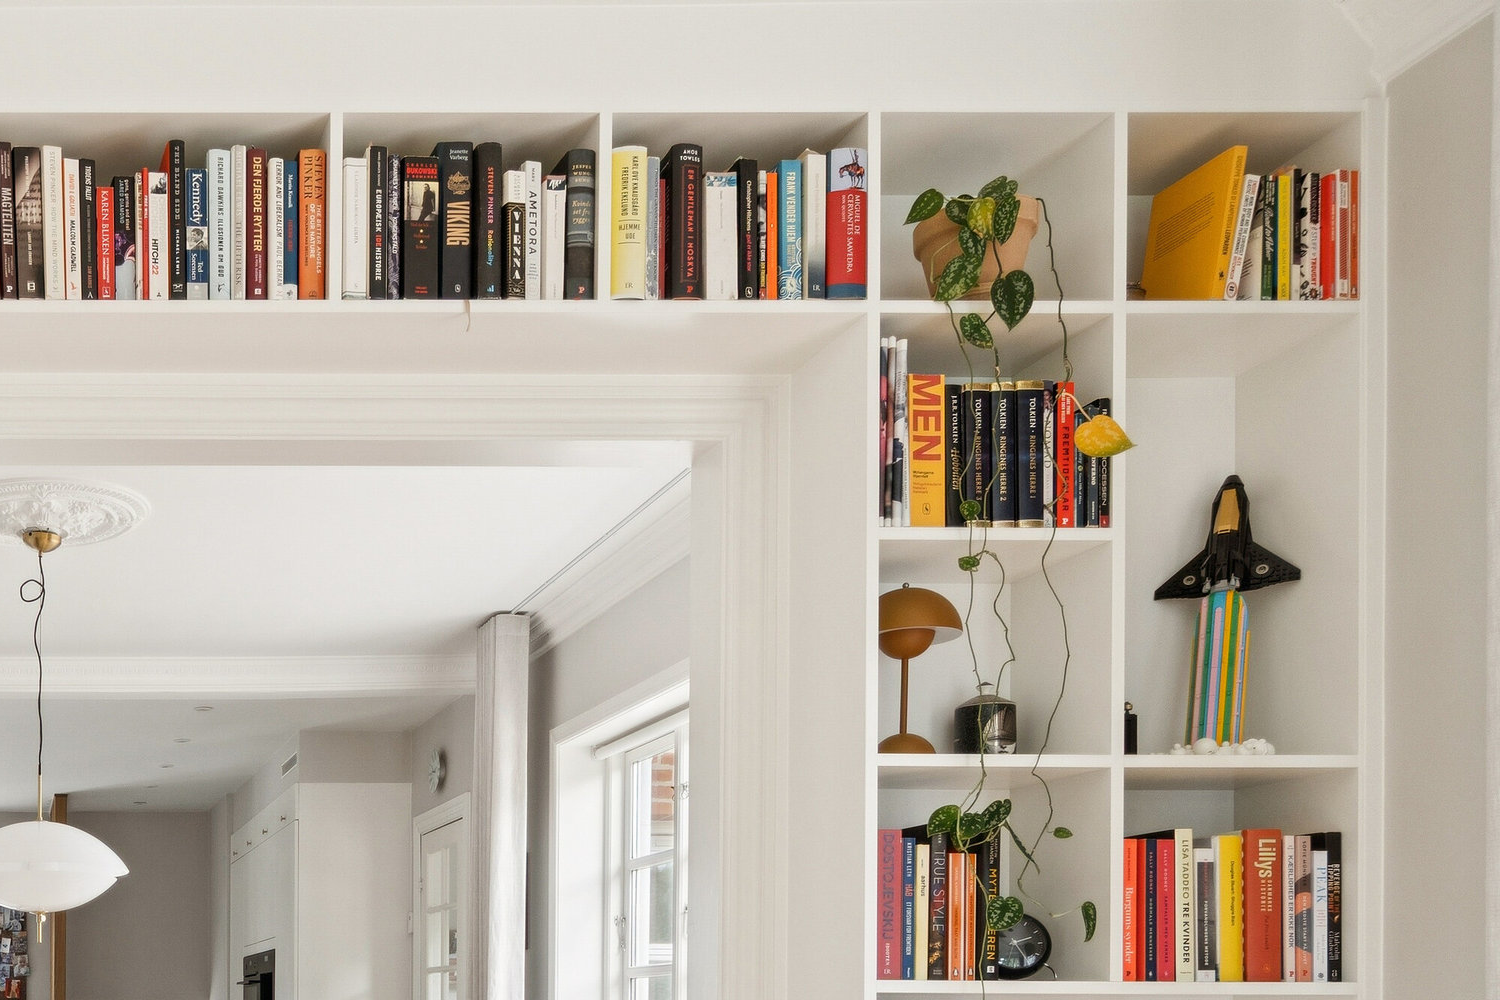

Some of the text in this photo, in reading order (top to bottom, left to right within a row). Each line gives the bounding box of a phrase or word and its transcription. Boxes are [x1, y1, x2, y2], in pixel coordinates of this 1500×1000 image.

[253, 157, 262, 176] DEN
[304, 156, 313, 199] PINKER
[314, 155, 322, 200] STEVEN
[621, 167, 629, 191] FREDRIK
[687, 169, 694, 179] EN
[190, 173, 202, 224] Kennedy
[253, 179, 262, 213] FJERDE
[631, 182, 639, 216] KNAUSGÅRD
[786, 172, 796, 242] FRANK VENDER HJEM
[1, 187, 13, 245] MAGTELITEN
[253, 215, 262, 252] RYTTER
[446, 201, 470, 246] VIKING
[529, 190, 537, 255] AMETORA
[854, 225, 860, 235] DE
[218, 254, 224, 263] OM
[486, 229, 494, 266] Rationality
[152, 264, 158, 275] 22
[912, 374, 941, 461] MEN
[1254, 839, 1276, 878] Lillys
[905, 884, 914, 897] HÅB
[932, 849, 945, 932] TRUE STYLE
[1316, 867, 1327, 903] PEAK
[1124, 887, 1134, 964] Bargums synder
